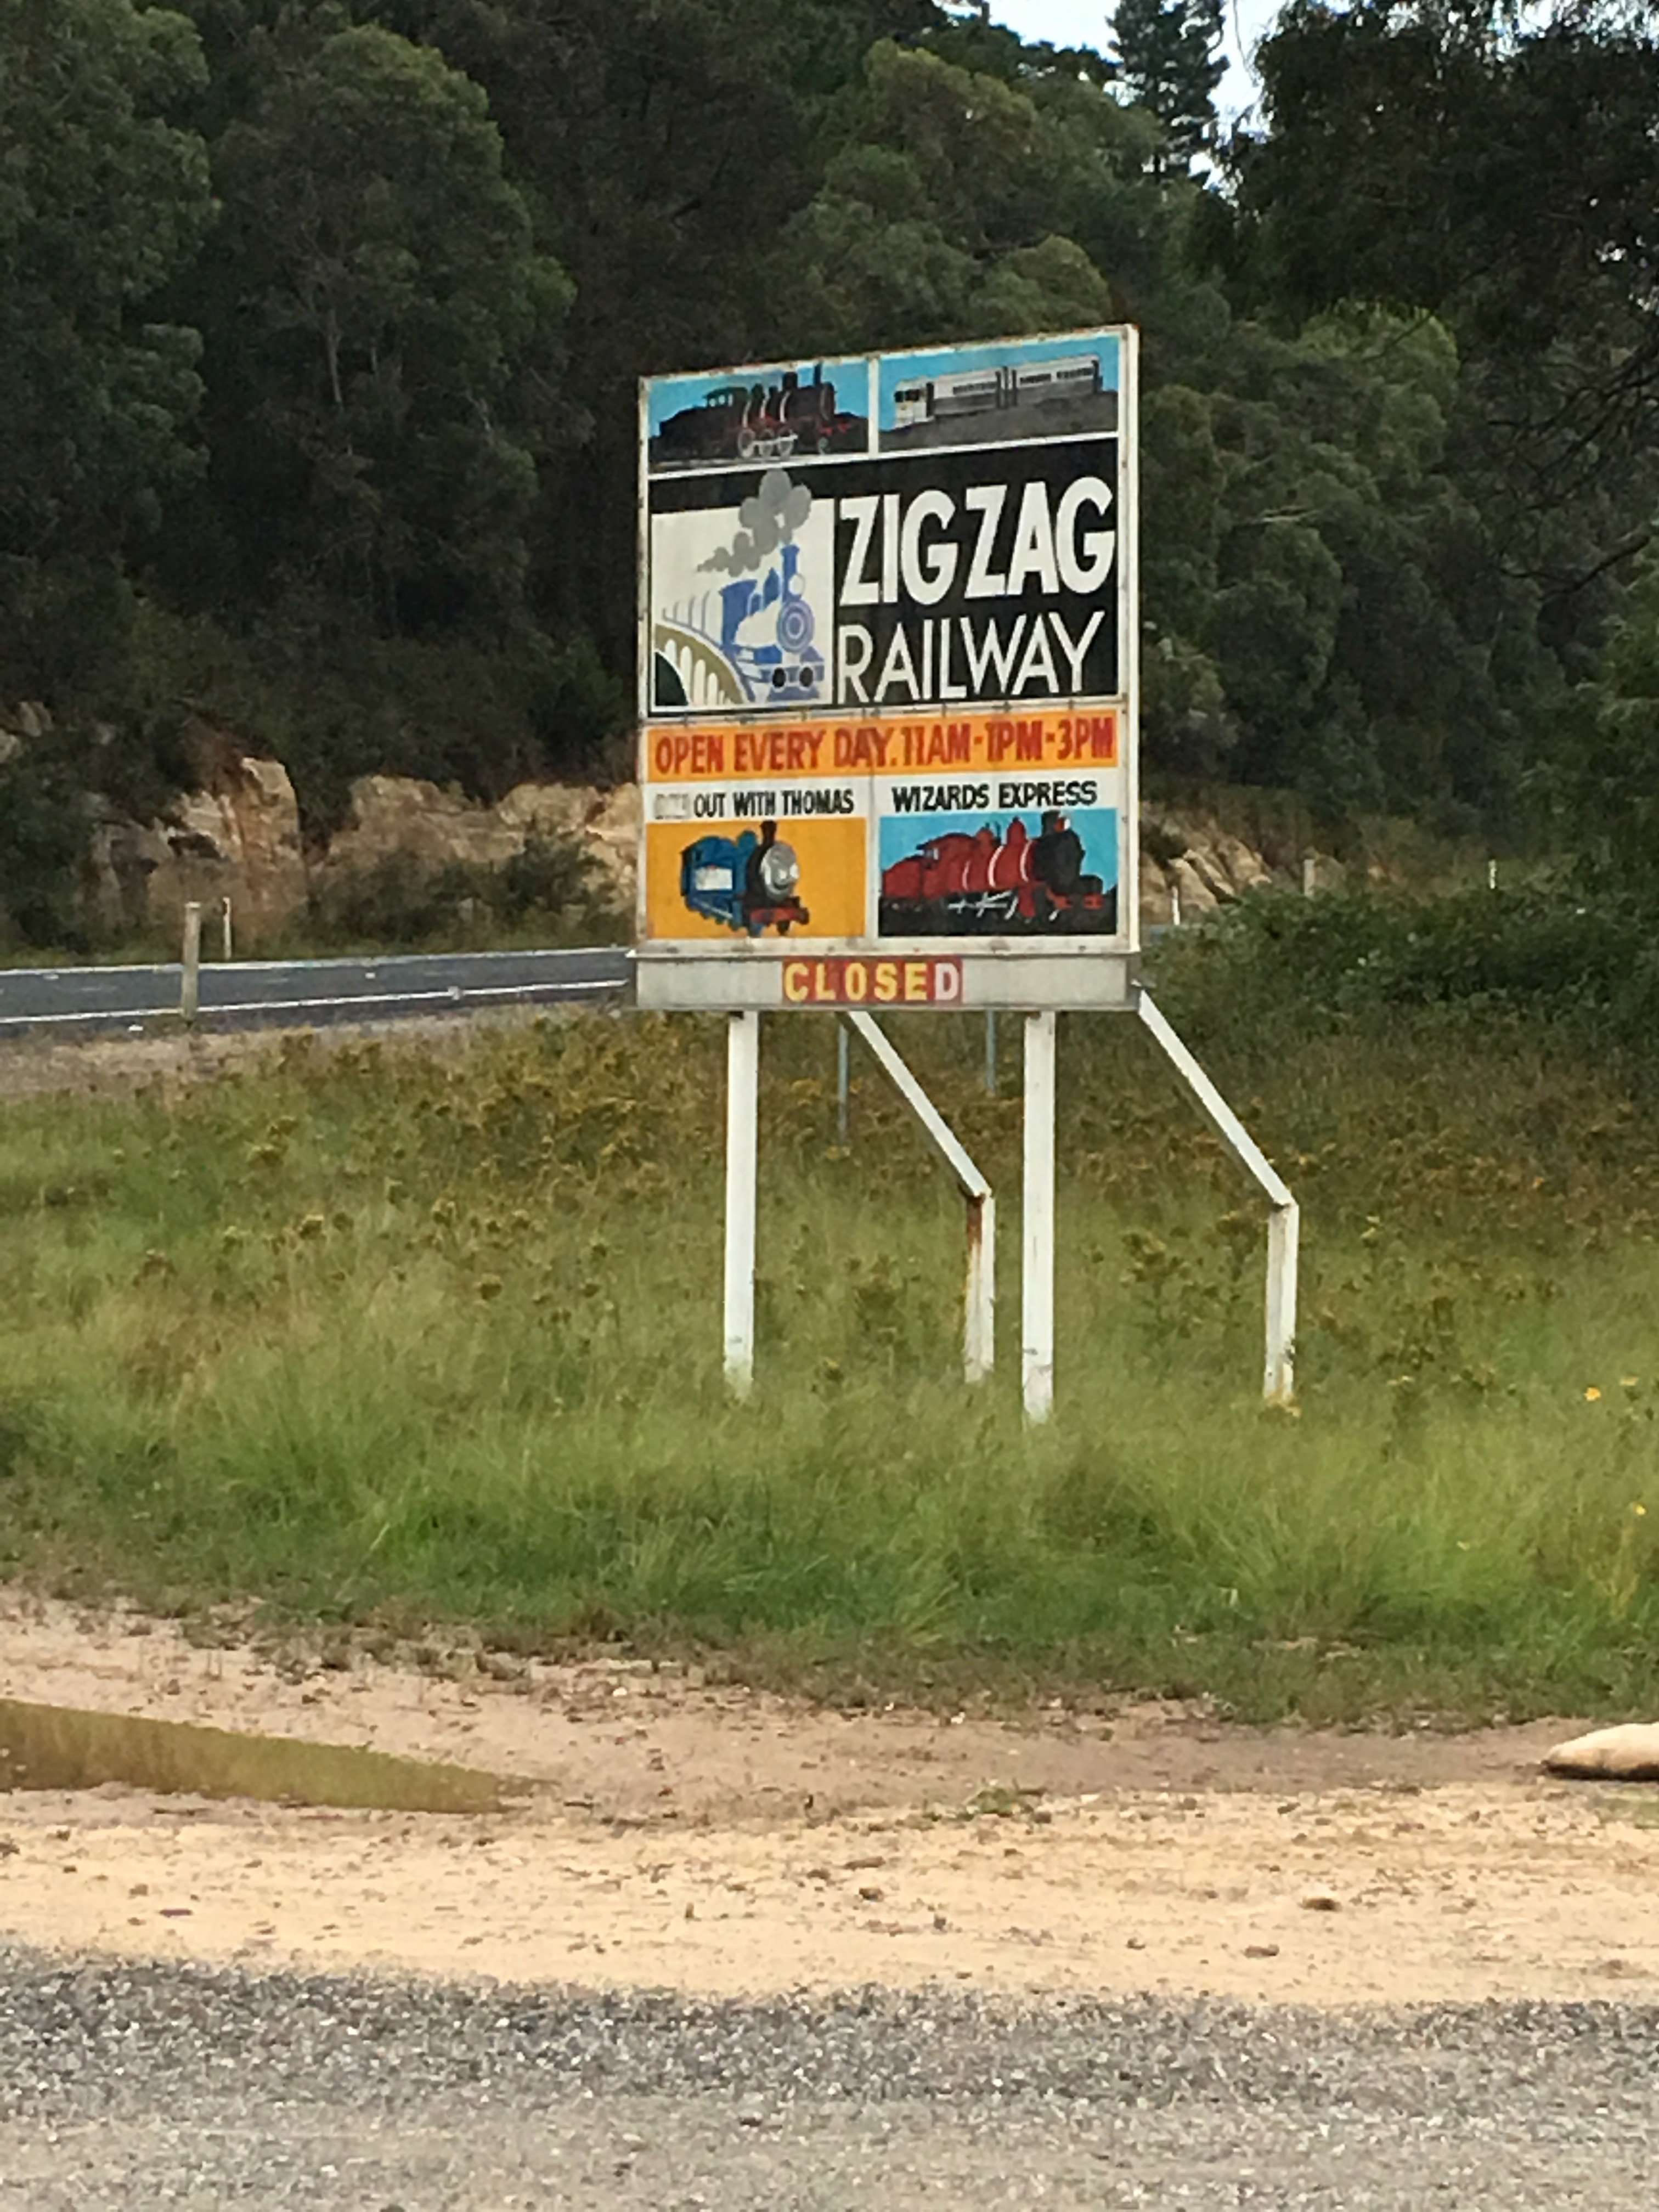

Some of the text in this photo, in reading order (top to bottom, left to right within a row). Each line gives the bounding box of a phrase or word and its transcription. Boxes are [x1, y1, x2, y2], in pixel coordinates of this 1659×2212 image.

[837, 610, 1105, 704] RAILWAY
[655, 735, 724, 775] OPEN
[733, 730, 827, 772] EVERY
[693, 792, 726, 818] OUT
[733, 791, 775, 817] WITH
[781, 788, 855, 815] THOMAS
[891, 780, 1098, 813] WIZARDS EXPRESS
[785, 962, 960, 1002] CLOSED
